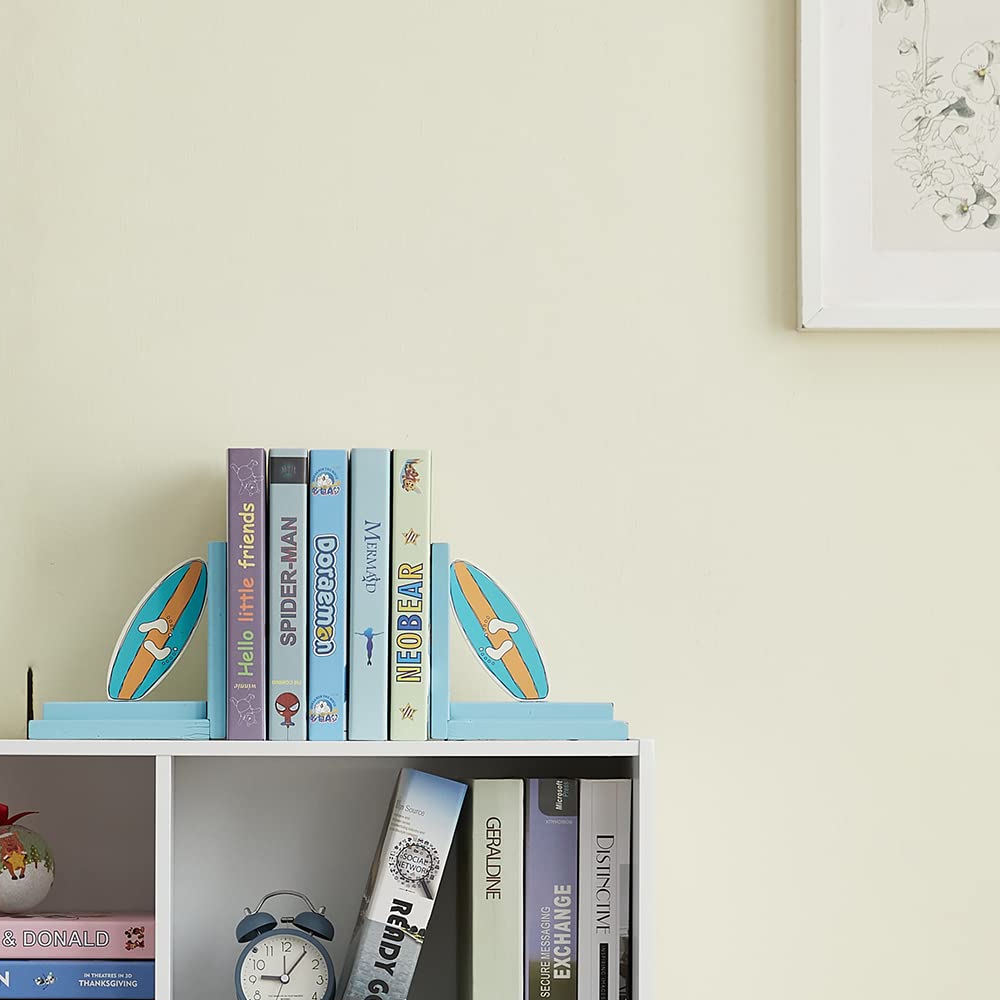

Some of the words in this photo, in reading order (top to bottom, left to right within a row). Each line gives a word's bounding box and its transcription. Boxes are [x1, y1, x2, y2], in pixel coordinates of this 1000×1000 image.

[238, 503, 255, 569] friends
[280, 516, 298, 646] SPIDER-MAN
[312, 534, 340, 657] Doraemon
[238, 578, 254, 622] little
[396, 563, 424, 683] NEOBEAR
[237, 631, 254, 676] Hello
[555, 780, 563, 811] Microsoft
[486, 816, 502, 900] GERALDINE
[596, 834, 615, 935] DISTINCTIVE
[1, 930, 17, 947] &
[22, 930, 110, 947] DONALD
[281, 941, 292, 953] 12
[540, 906, 551, 960] MESSAGING
[553, 885, 572, 980] EXCHANGE
[253, 959, 266, 971] 10
[265, 945, 274, 957] 11
[311, 959, 320, 970] 2
[78, 979, 138, 988] THANKSGIVING
[249, 975, 257, 985] 9
[253, 990, 261, 1000] 8
[311, 991, 318, 1000] 4
[316, 975, 324, 986] 3
[540, 960, 551, 998] SECURE
